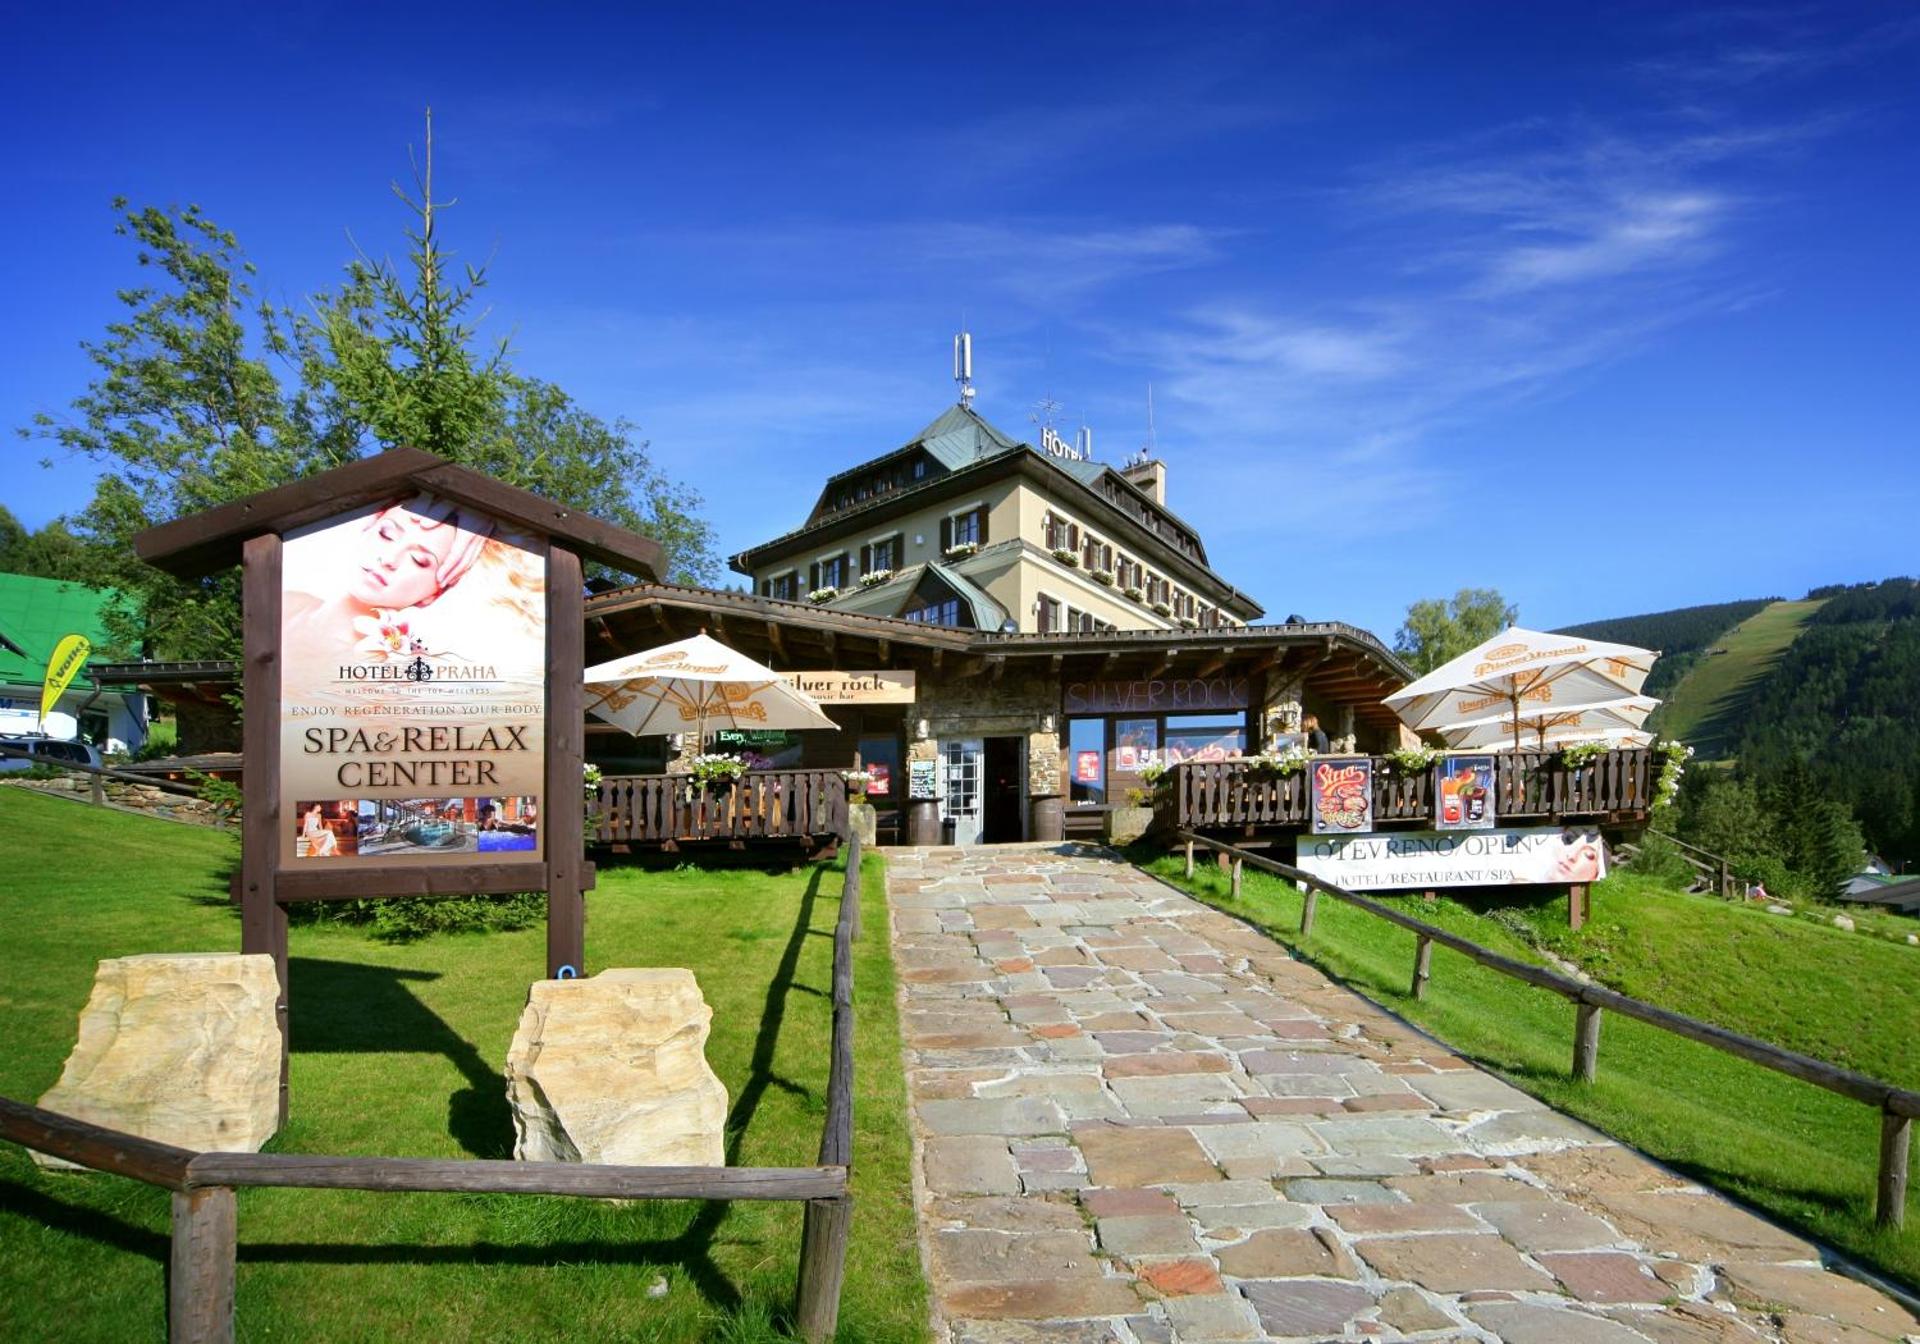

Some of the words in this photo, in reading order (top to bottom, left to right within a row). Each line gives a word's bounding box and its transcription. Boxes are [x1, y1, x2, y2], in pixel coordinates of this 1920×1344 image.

[339, 665, 403, 680] HOTEL
[436, 664, 497, 680] PRAHA
[841, 673, 884, 690] rock
[1068, 681, 1165, 713] SILVER
[1173, 679, 1249, 710] ROCK
[291, 706, 337, 717] ENJOY
[344, 704, 455, 716] REGENERATION
[461, 704, 499, 715] YOUR
[504, 703, 543, 714] BODY
[337, 760, 500, 787] CENTER
